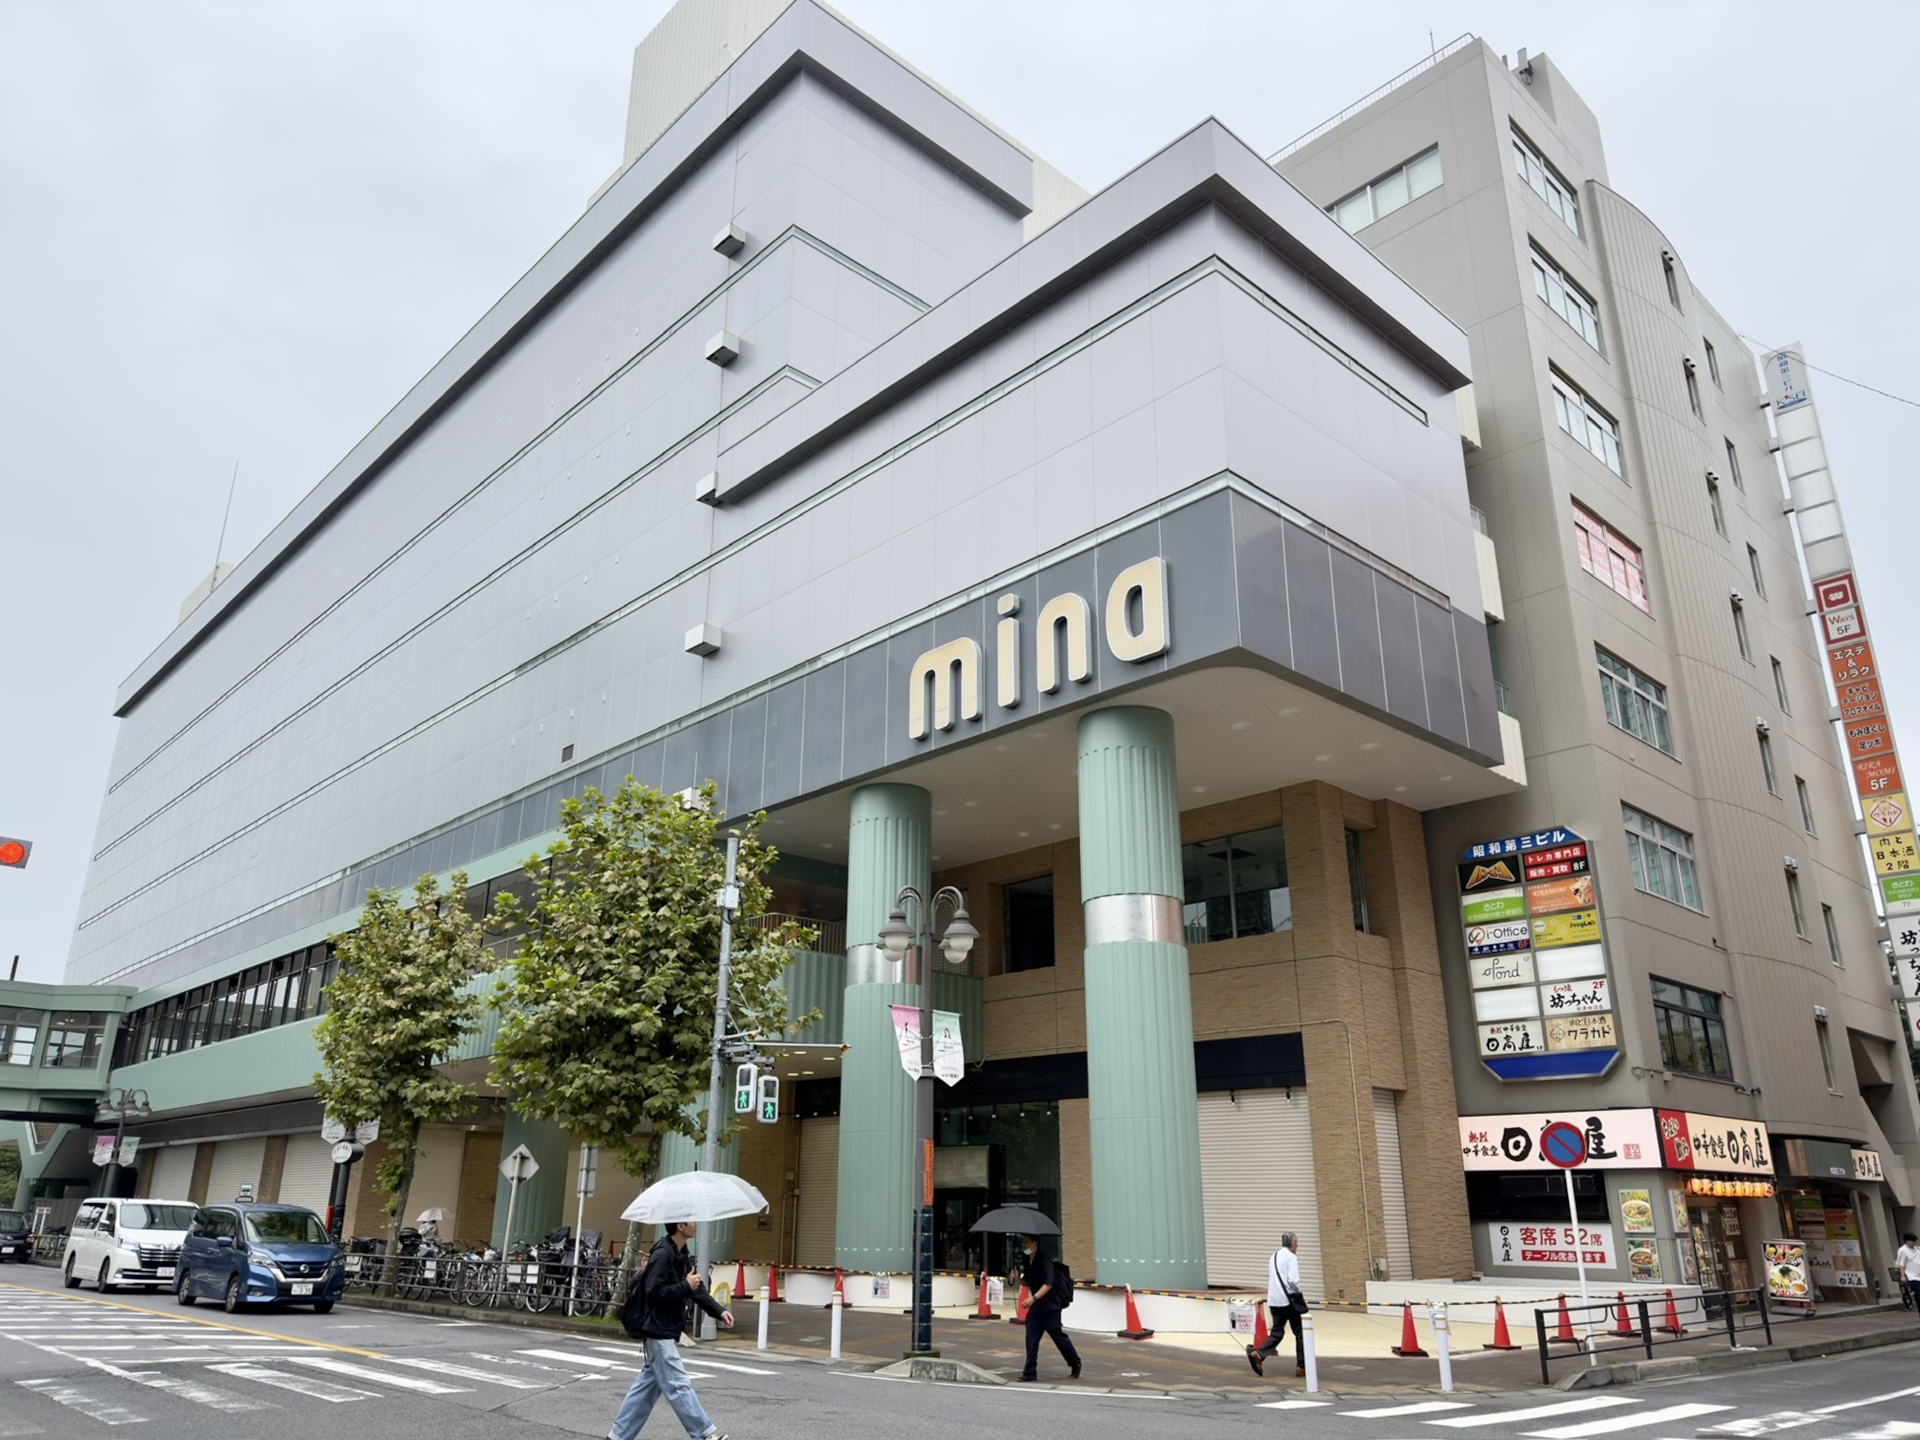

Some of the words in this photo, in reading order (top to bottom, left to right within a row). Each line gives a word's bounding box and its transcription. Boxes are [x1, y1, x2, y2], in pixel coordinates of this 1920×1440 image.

[1837, 624, 1851, 635] 5F
[909, 556, 1170, 740] mina
[1833, 645, 1866, 660] エステ
[1847, 658, 1857, 668] &
[1838, 666, 1870, 681] リラク
[1847, 685, 1868, 695] キャビ
[1842, 692, 1878, 706] テーション
[1844, 702, 1881, 717] アロマオイル
[1849, 724, 1886, 738] もみほぐし
[1870, 778, 1888, 790] 5F
[1473, 830, 1566, 857] 昭和第三ビル
[1879, 836, 1903, 847] 肉と
[1528, 847, 1581, 864] トレカ専門店
[1876, 845, 1915, 860] 日本酒
[1529, 864, 1568, 878] 販売・買取
[1573, 861, 1585, 871] 8F
[1886, 860, 1910, 870] 2階
[1483, 901, 1505, 911] さとわ
[1486, 926, 1528, 940] i-Office
[1593, 981, 1605, 989] 2F
[1550, 990, 1602, 1009] 坊っちゃん
[1568, 1024, 1611, 1041] ワラカド
[1486, 1032, 1535, 1052] 日高屋
[1501, 1116, 1618, 1163] 日屋
[1693, 1129, 1727, 1159] 中華食堂
[1726, 1126, 1768, 1168] 日高屋
[1462, 1144, 1499, 1157] 中華食堂
[1500, 1225, 1513, 1262] 日高屋
[1520, 1227, 1558, 1246] 客席
[1524, 1251, 1602, 1262] テーブル席あます
